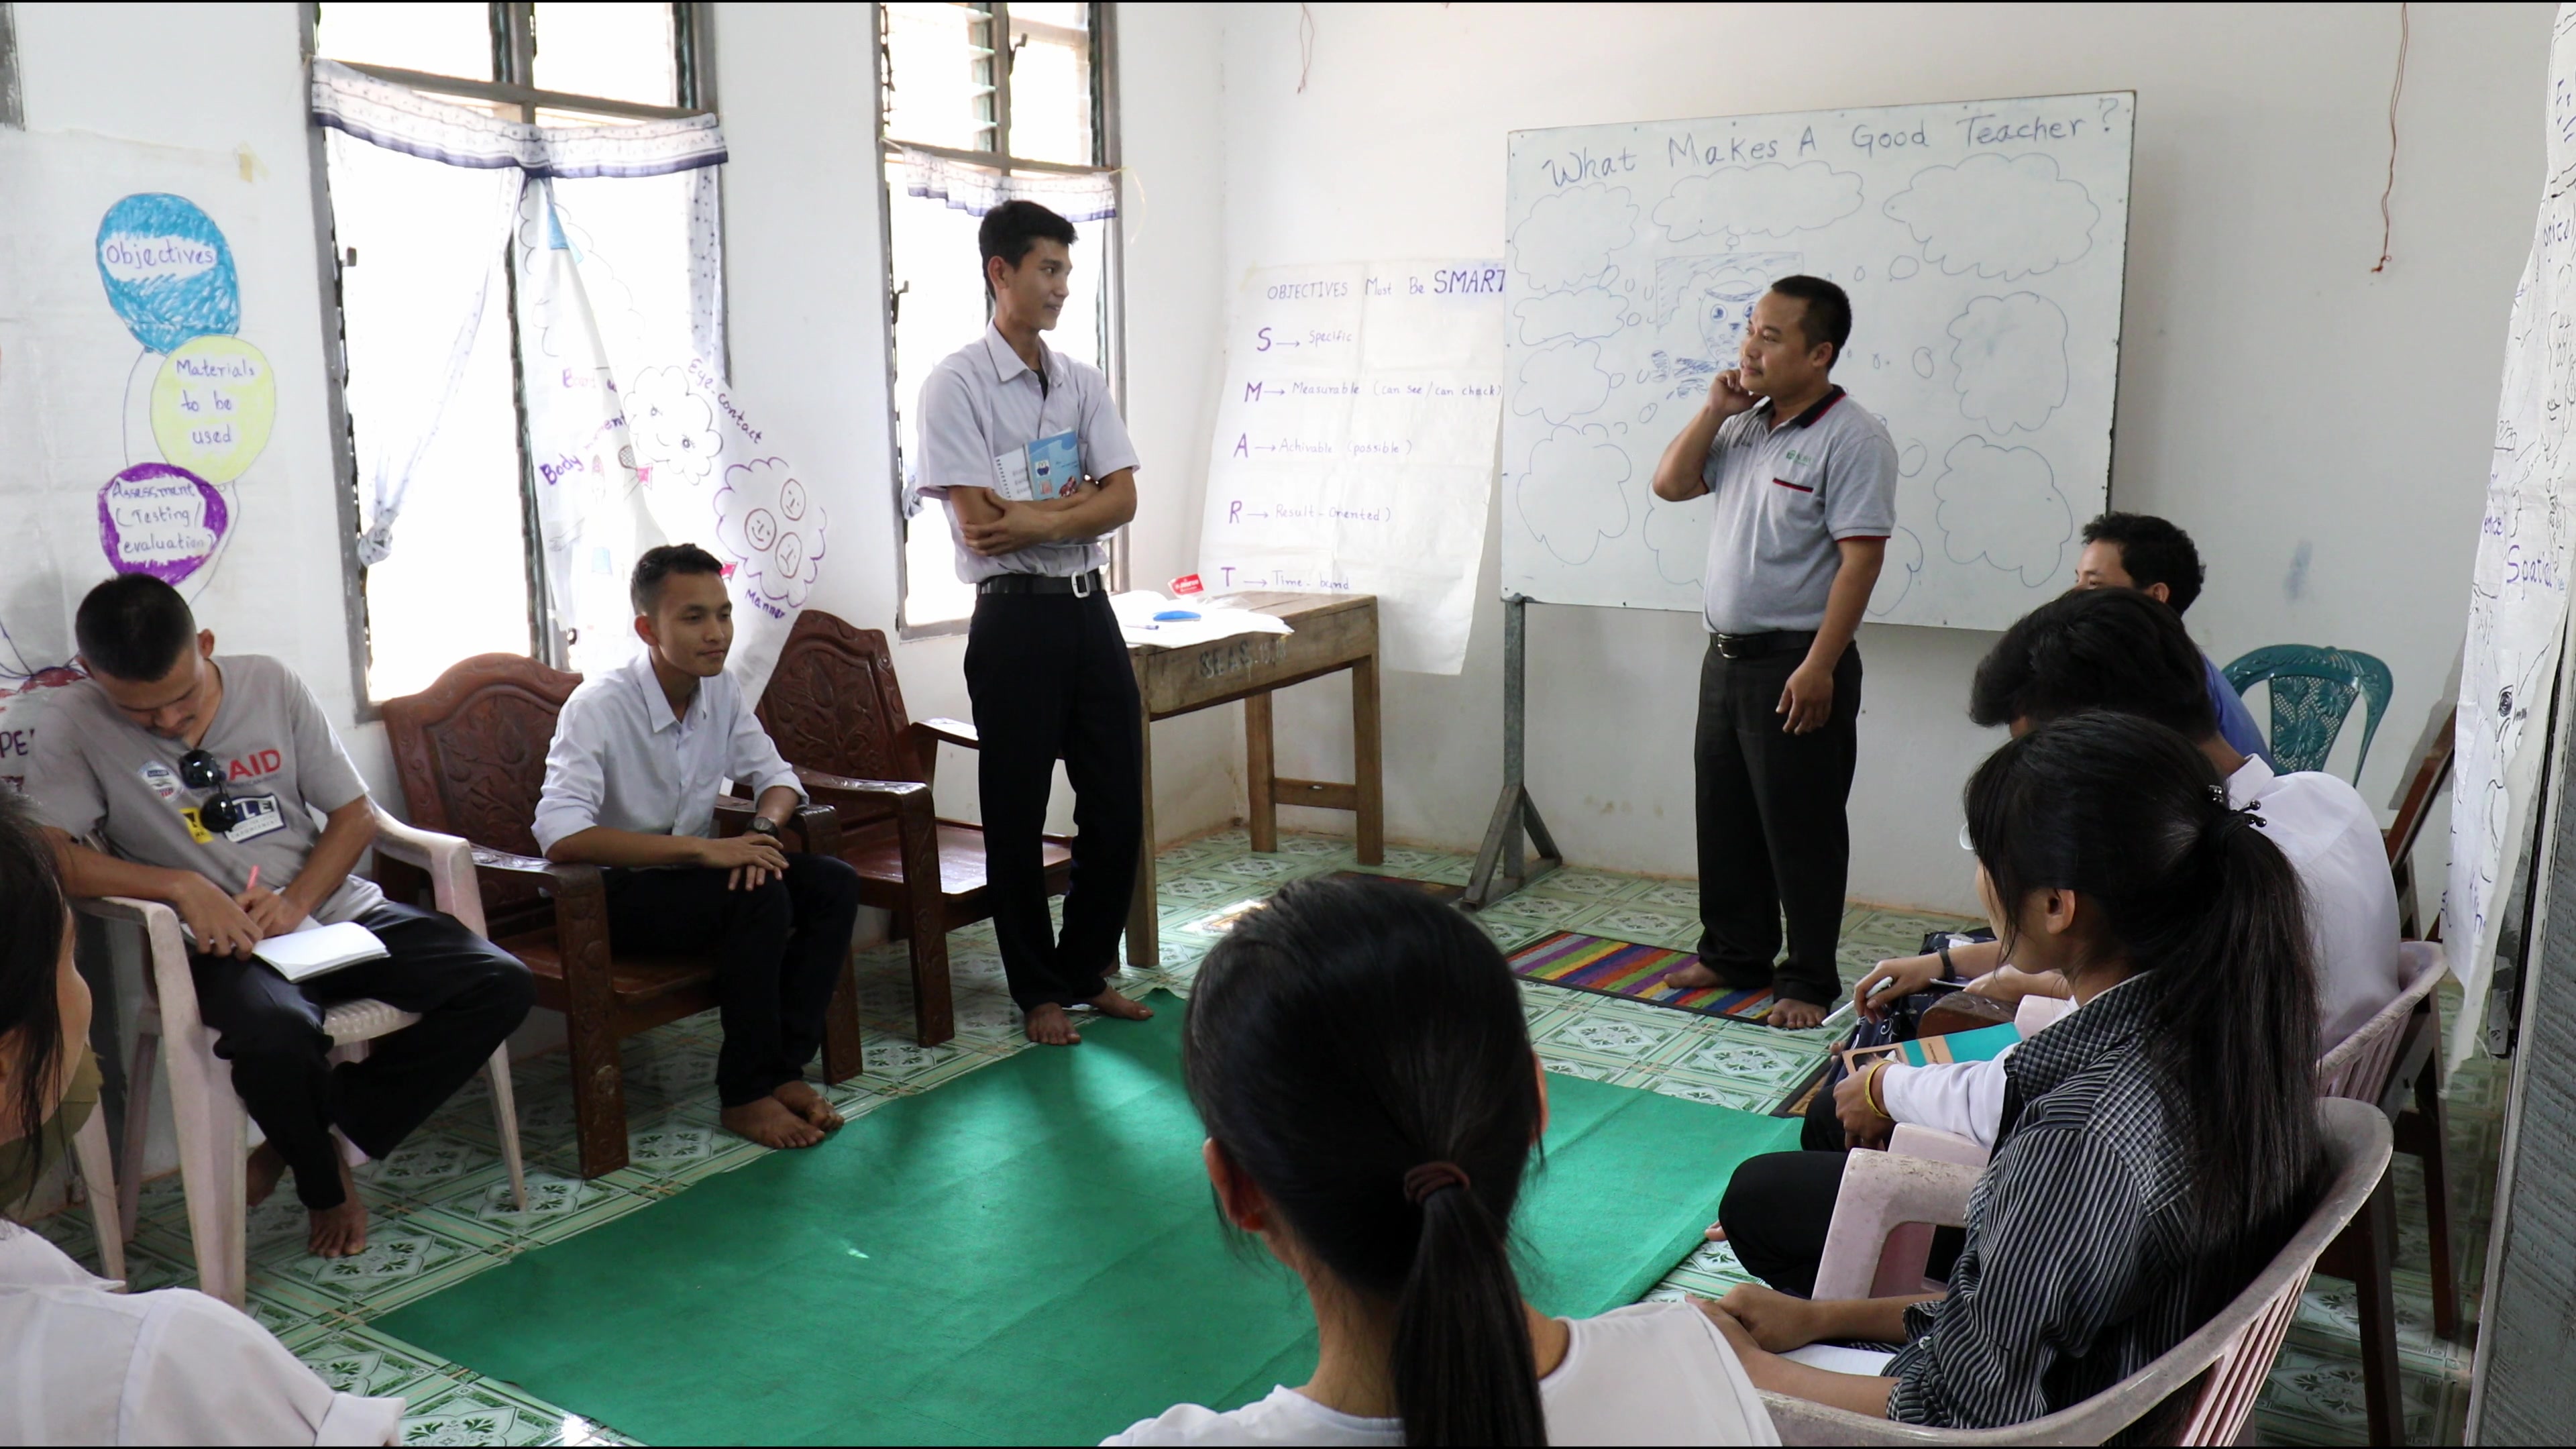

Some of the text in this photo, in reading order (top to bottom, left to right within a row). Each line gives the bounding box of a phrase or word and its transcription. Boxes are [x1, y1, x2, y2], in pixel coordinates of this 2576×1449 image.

[1542, 146, 1637, 187] What
[1668, 133, 1778, 169] Makes
[1797, 127, 1817, 155] A
[1851, 119, 1929, 150] Good
[106, 243, 215, 270] Objectives
[1267, 280, 1348, 301] OBJECTIVES
[1409, 276, 1425, 294] Be
[1434, 268, 1505, 293] SMART
[1256, 327, 1352, 352] S Specific
[176, 359, 256, 378] Materials
[182, 390, 232, 412] to be
[688, 358, 763, 445] Eye-contact
[1244, 380, 1263, 402] M
[1292, 382, 1360, 394] Measurable
[193, 424, 232, 445] used
[1234, 433, 1248, 459] A
[539, 453, 584, 486] Body
[113, 480, 195, 498] Assessment
[1229, 500, 1242, 524] R
[1221, 566, 1236, 588] T
[745, 588, 786, 619] Manner
[228, 749, 281, 781] AID
[236, 800, 274, 819] LE
